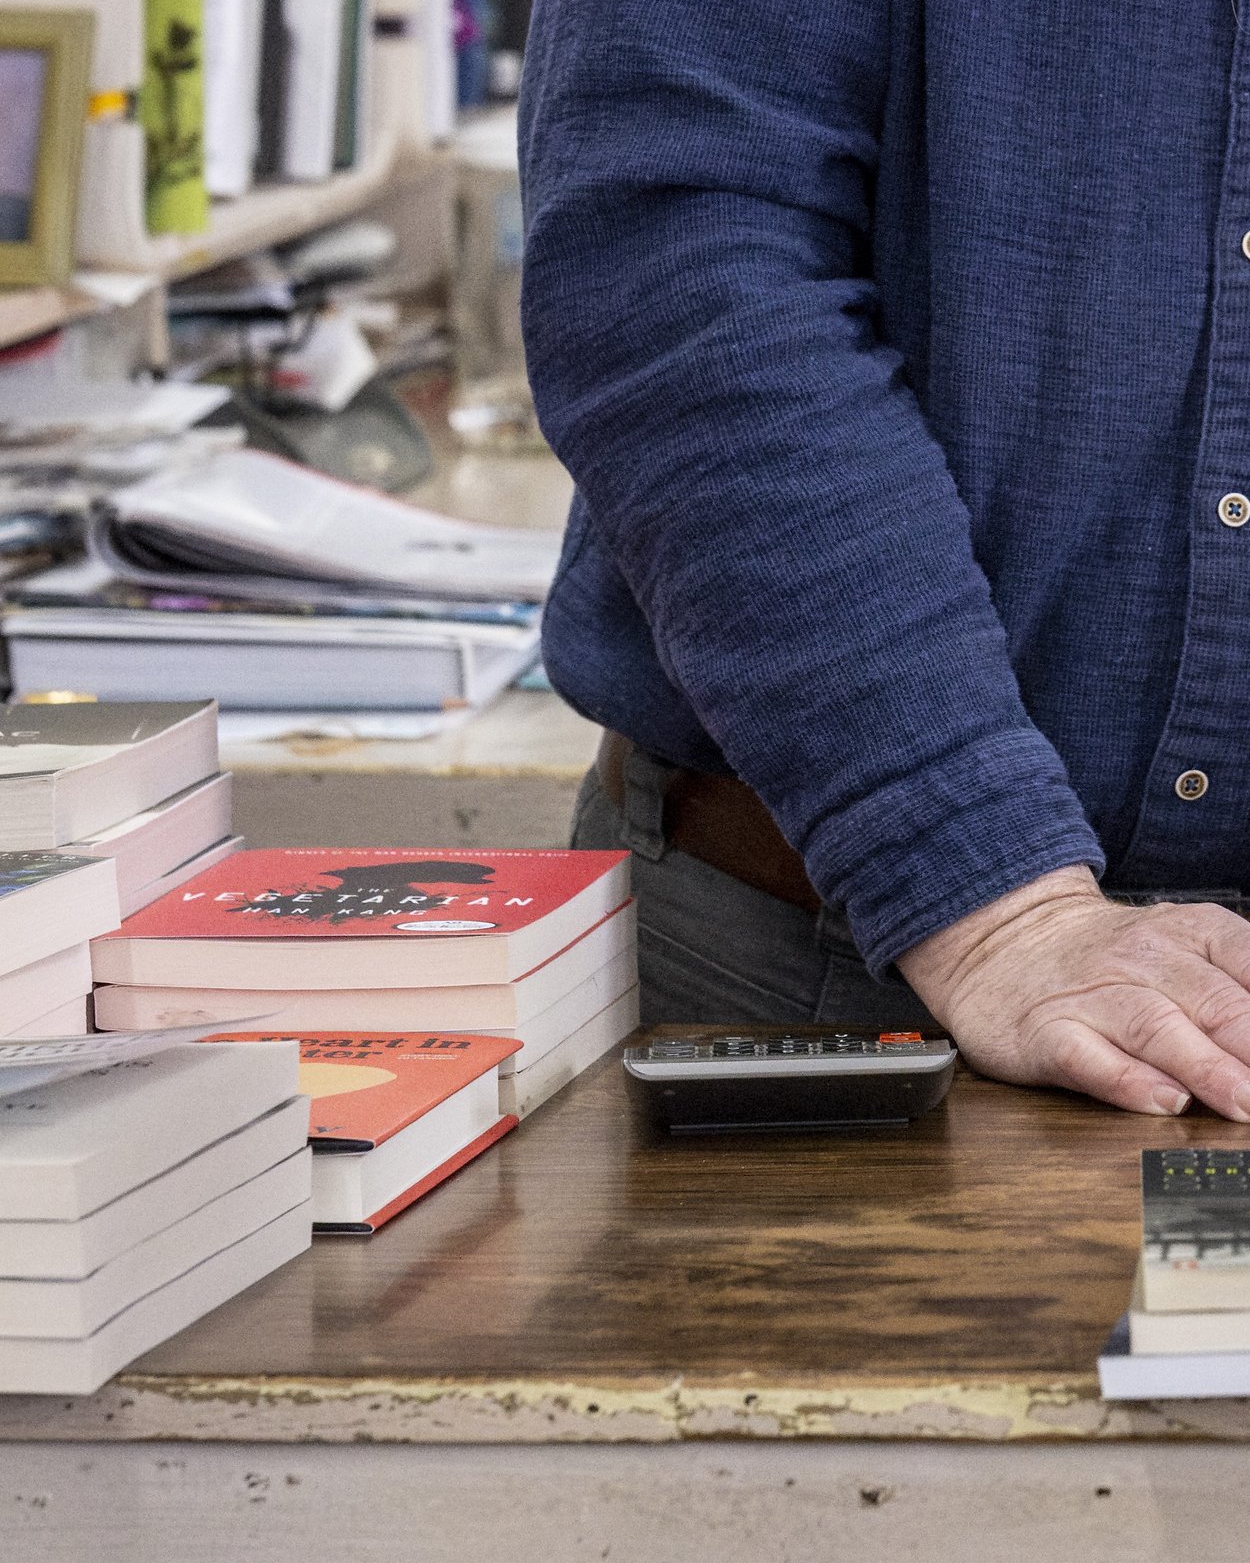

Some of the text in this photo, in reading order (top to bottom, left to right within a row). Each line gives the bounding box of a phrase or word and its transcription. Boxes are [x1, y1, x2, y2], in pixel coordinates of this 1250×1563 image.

[181, 892, 535, 906] VEGETARIAN
[336, 908, 429, 916] KANG
[416, 1037, 473, 1050] In
